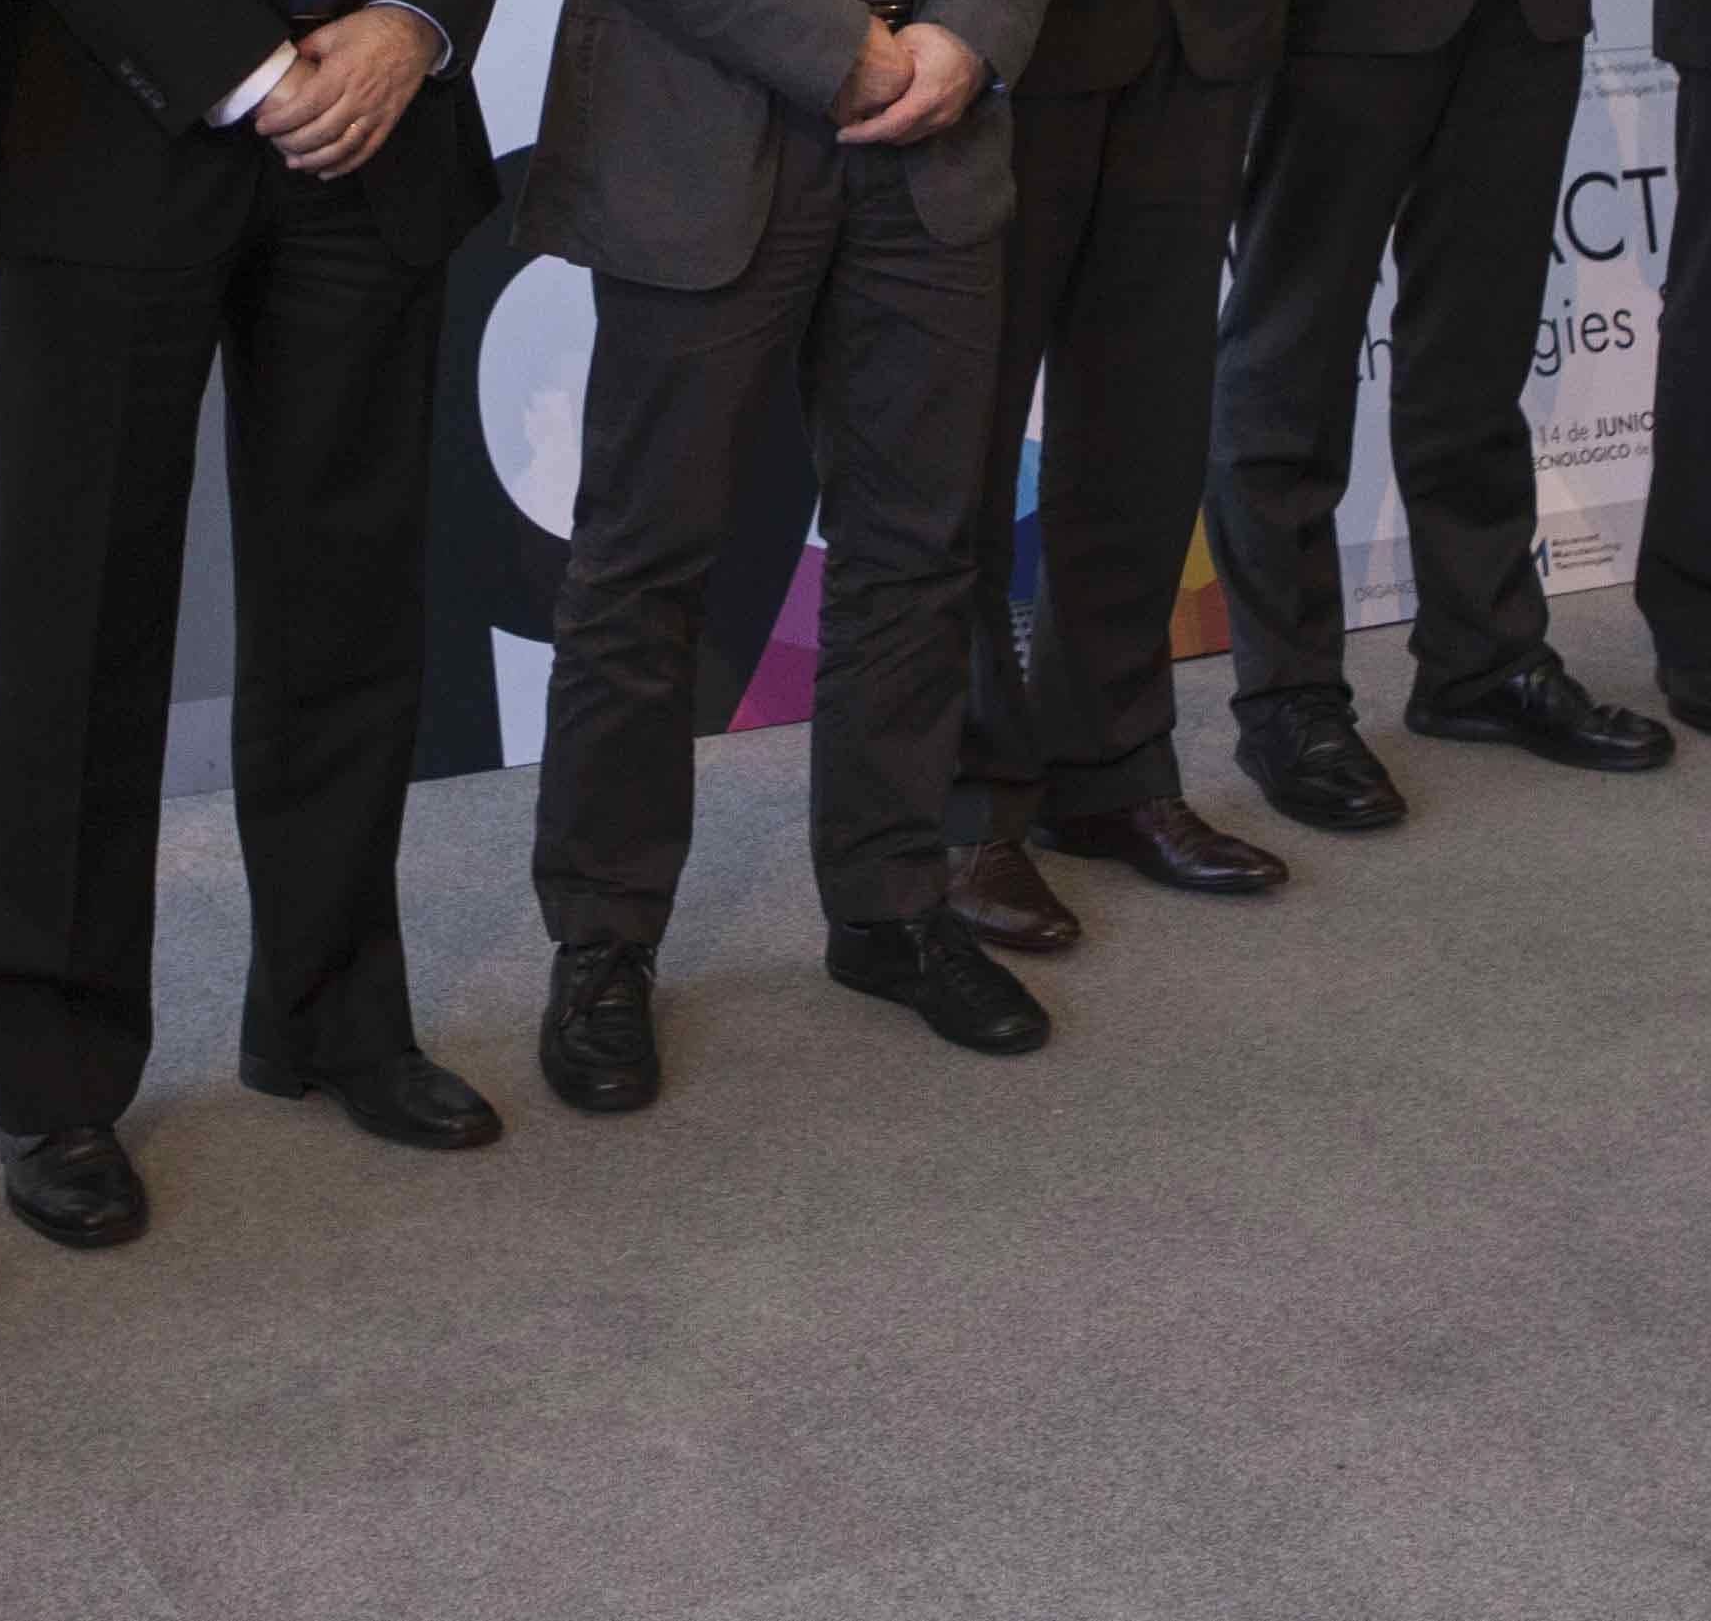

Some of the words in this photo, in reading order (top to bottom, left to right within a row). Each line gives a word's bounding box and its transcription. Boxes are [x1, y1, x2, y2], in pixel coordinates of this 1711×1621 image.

[1551, 166, 1668, 265] CT
[1567, 421, 1589, 443] de
[1594, 410, 1655, 439] JUNIO
